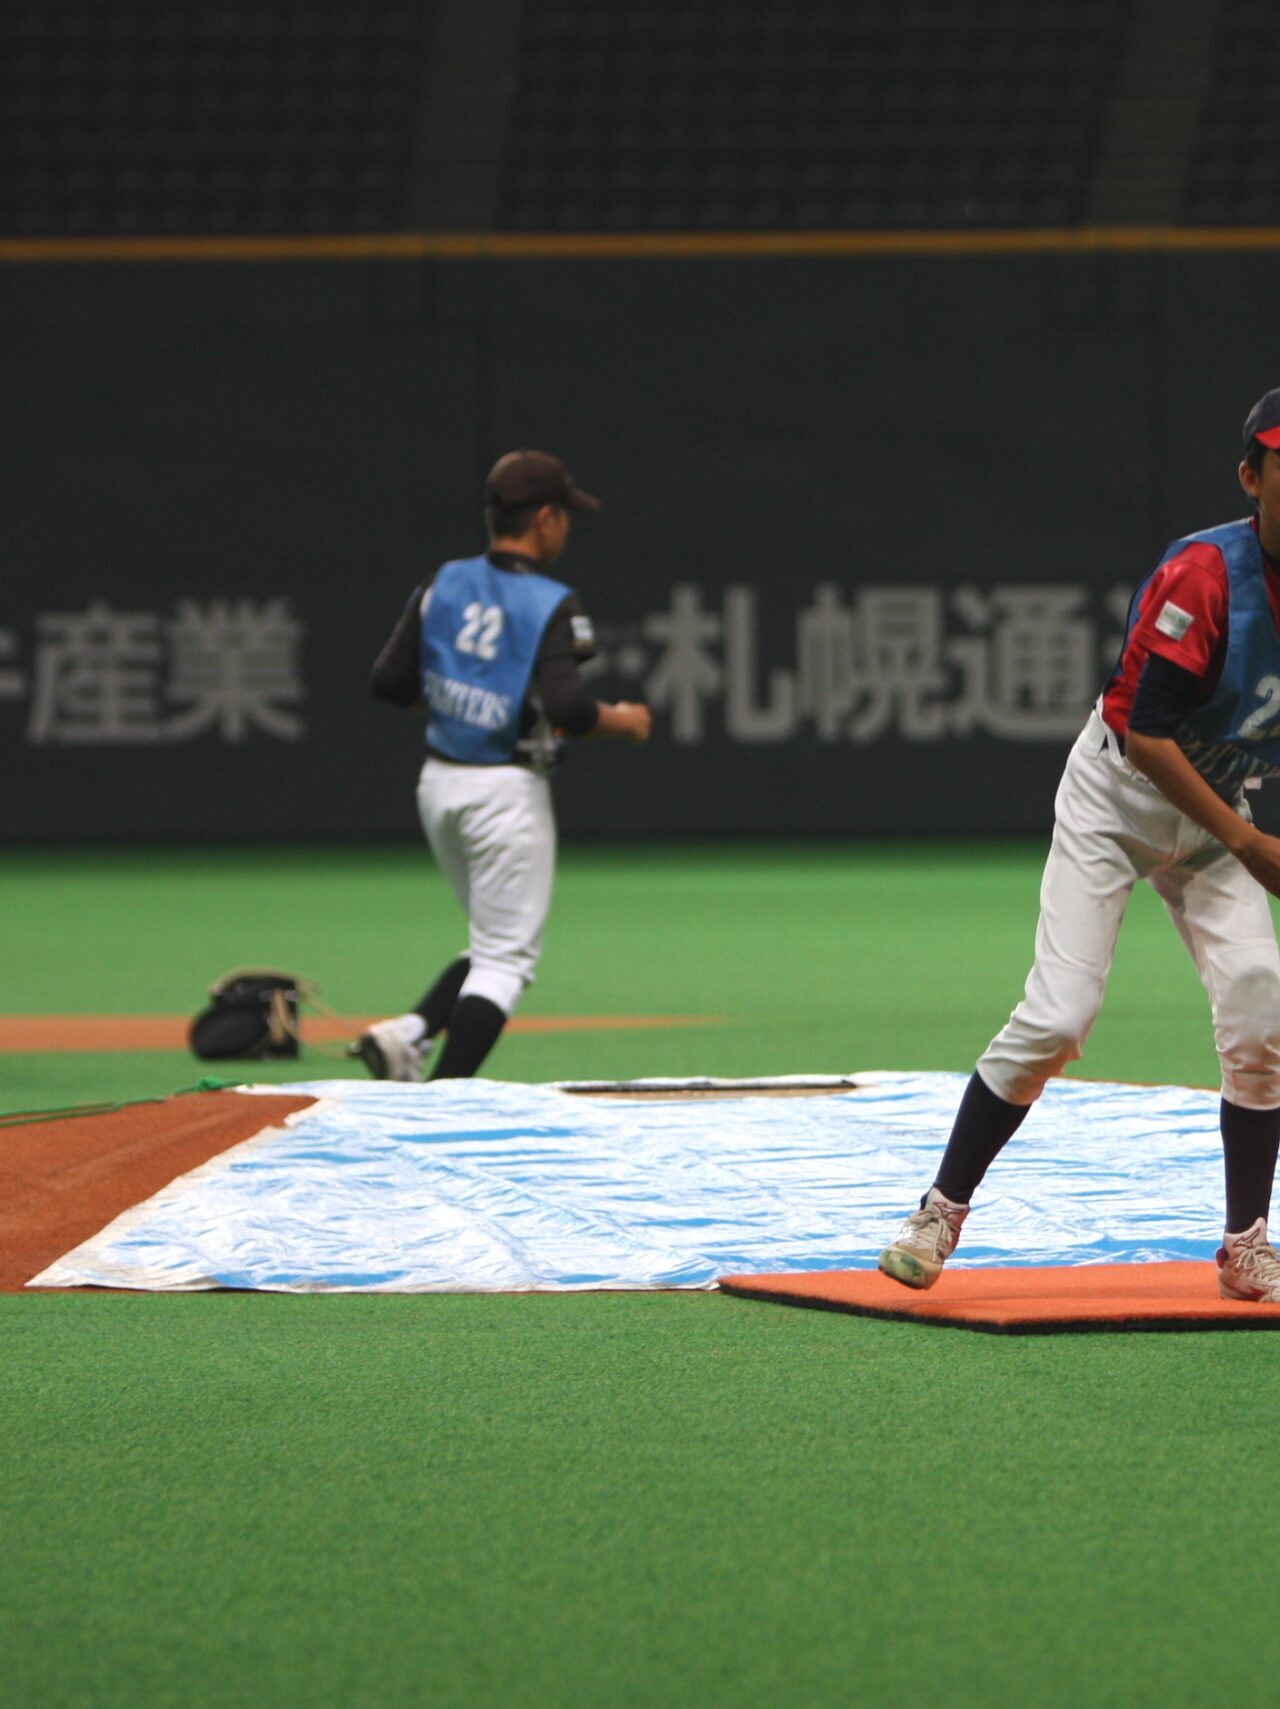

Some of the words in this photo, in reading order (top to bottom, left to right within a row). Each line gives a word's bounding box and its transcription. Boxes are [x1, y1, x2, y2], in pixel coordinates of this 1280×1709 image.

[0, 598, 306, 746] 産業
[455, 602, 503, 660] 22
[642, 582, 1133, 744] 札幌通
